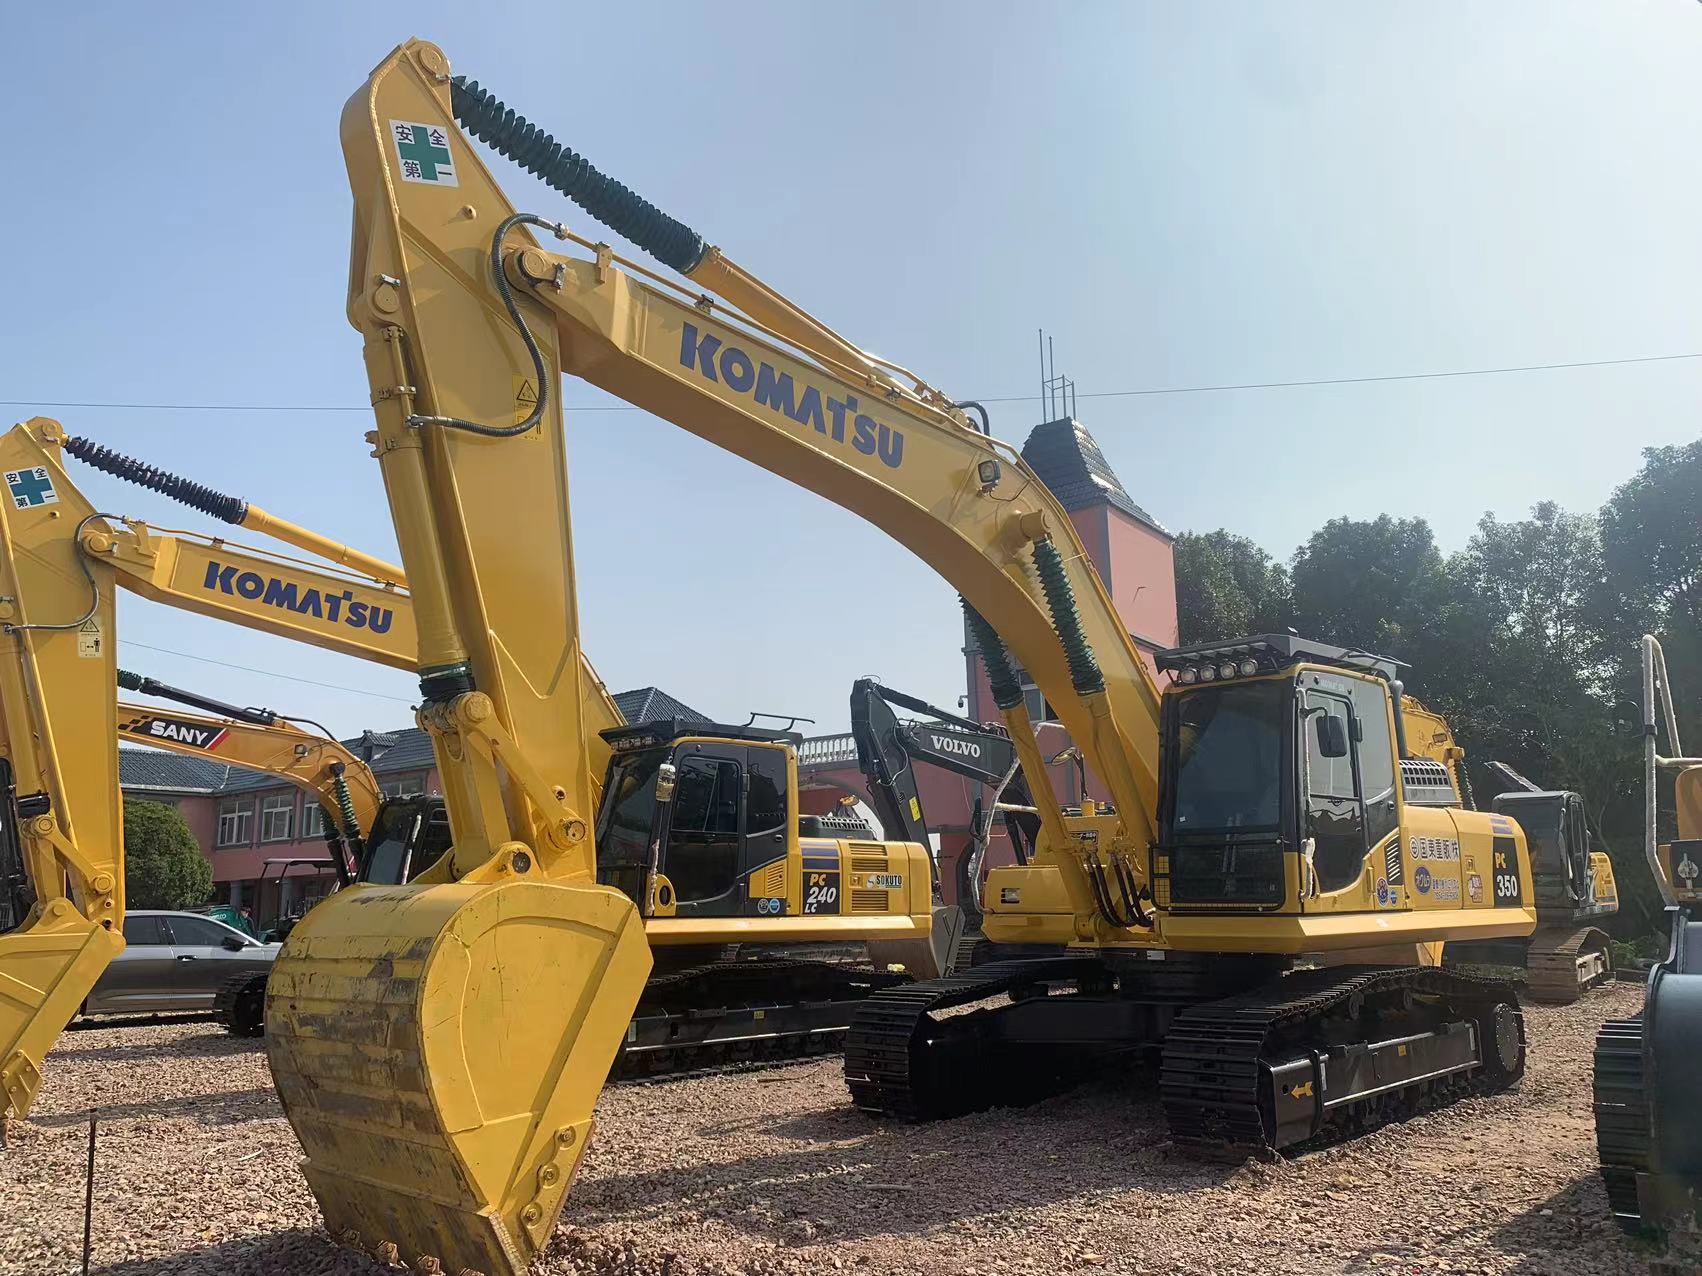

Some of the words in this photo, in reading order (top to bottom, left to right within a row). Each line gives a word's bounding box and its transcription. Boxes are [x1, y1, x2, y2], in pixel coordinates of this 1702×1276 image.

[395, 124, 447, 147] 安全
[403, 160, 453, 178] 第一
[680, 321, 904, 469] KOMATSU
[203, 560, 393, 634] KOMATSU
[150, 720, 208, 745] SANY
[930, 735, 981, 758] VOLVO
[1494, 852, 1507, 869] PC
[809, 873, 827, 886] PC
[876, 874, 903, 886] SOKUTO
[1496, 875, 1517, 897] 350
[806, 886, 837, 904] 240
[804, 903, 818, 913] LC
